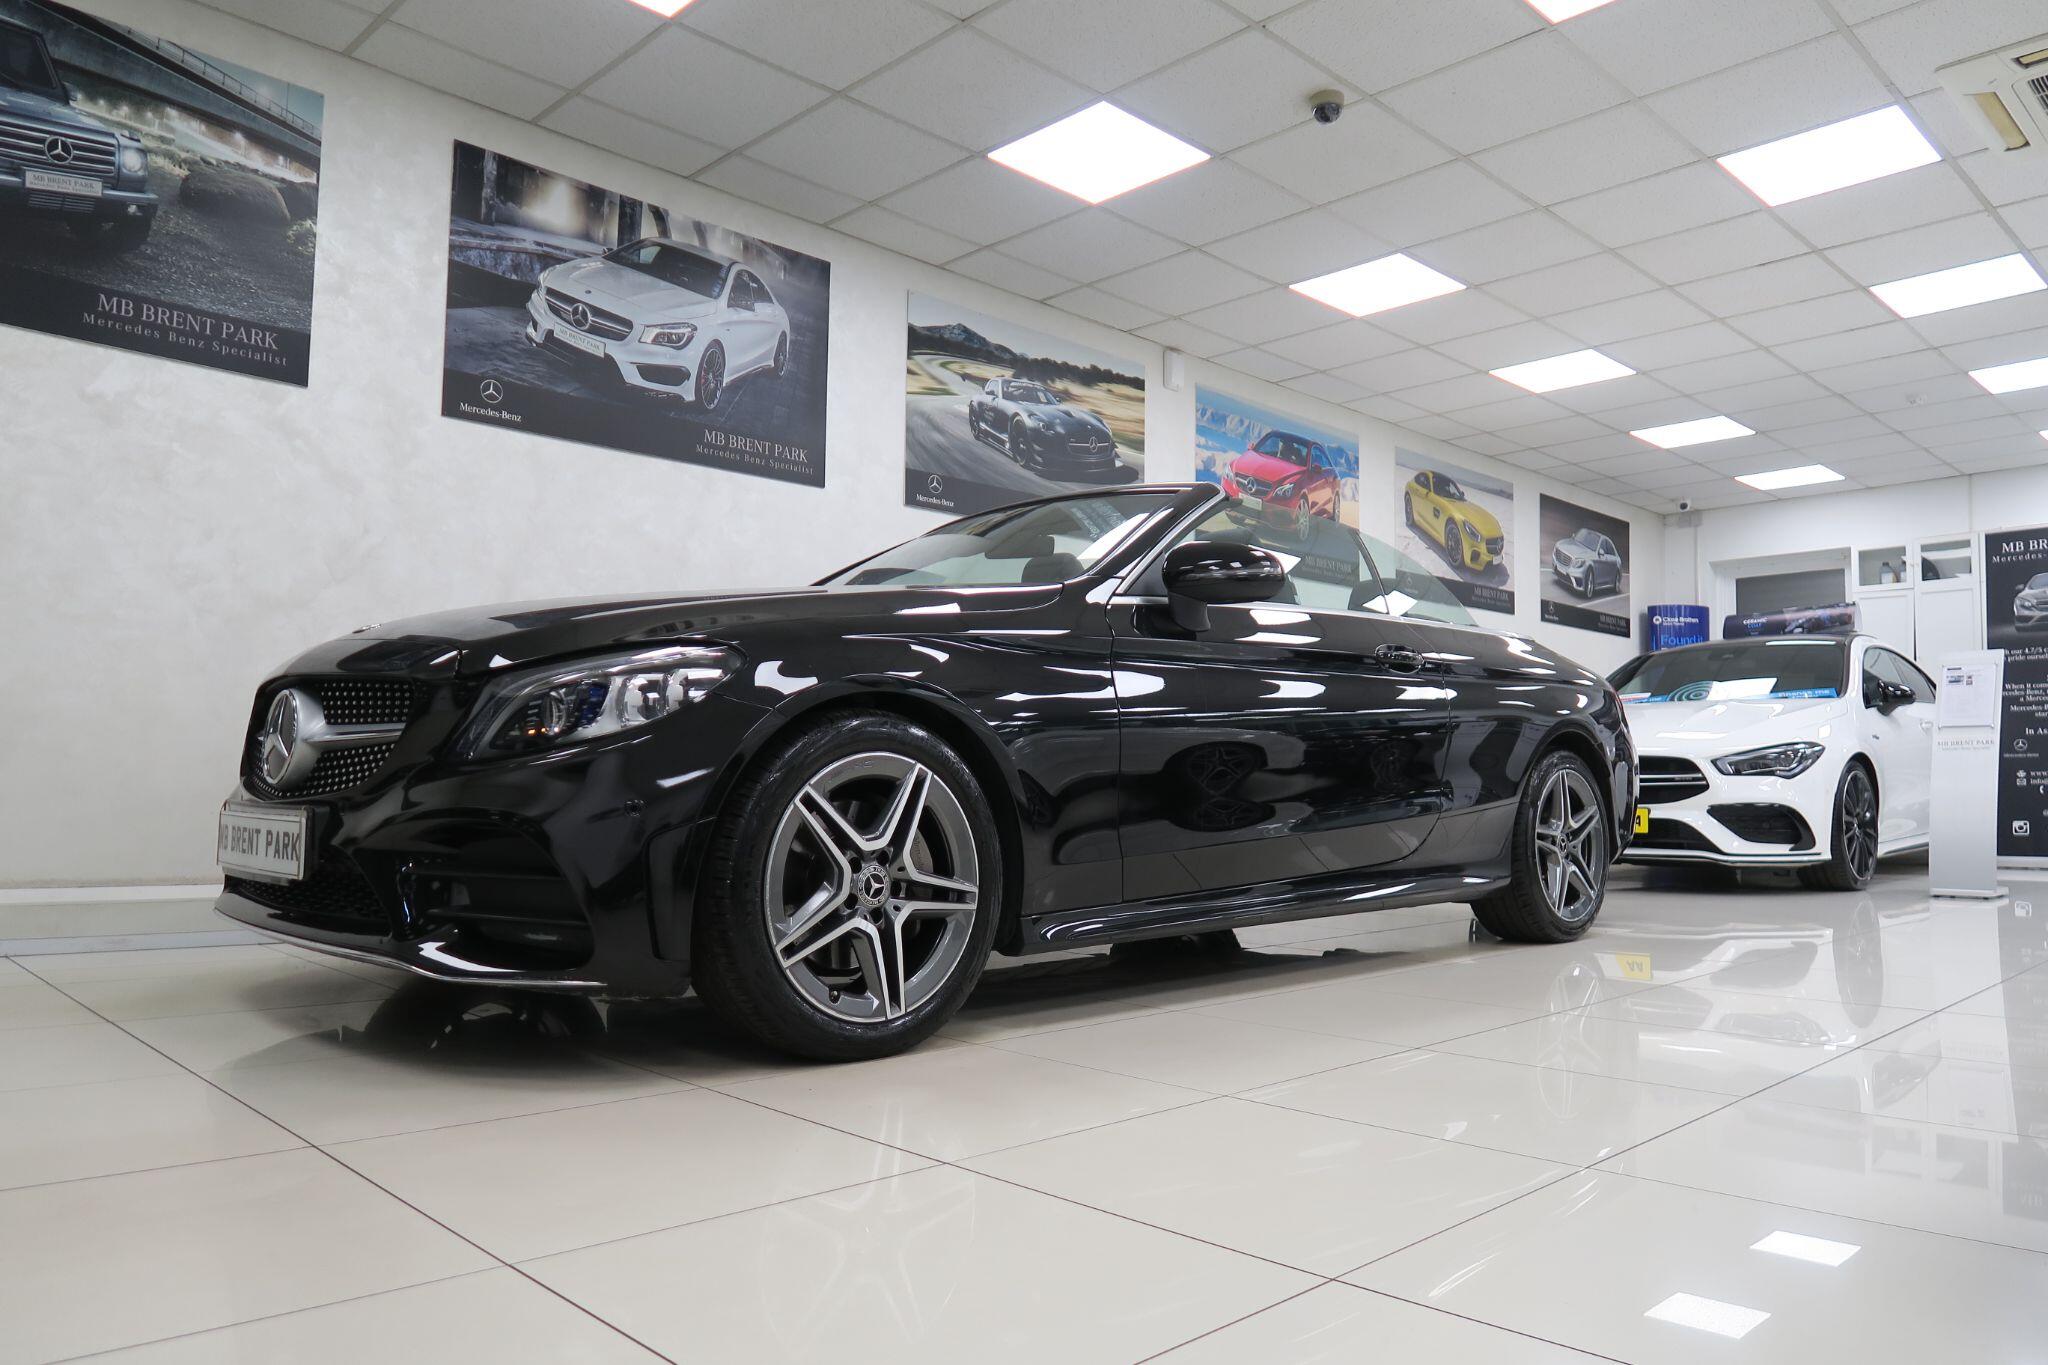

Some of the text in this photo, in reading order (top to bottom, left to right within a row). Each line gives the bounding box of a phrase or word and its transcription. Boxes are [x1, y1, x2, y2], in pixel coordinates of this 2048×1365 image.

[98, 294, 279, 350] MB BRENT PARK
[83, 312, 287, 366] Mercedes Benz Specialist
[459, 402, 522, 423] Mercedes-Benz
[696, 444, 814, 475] Mercedes Benz Specialist
[704, 429, 808, 463] MB BRENT PARK
[2002, 538, 2048, 553] MB BR
[1661, 635, 1696, 645] Found
[230, 825, 261, 856] BRENT
[265, 829, 300, 862] PARK
